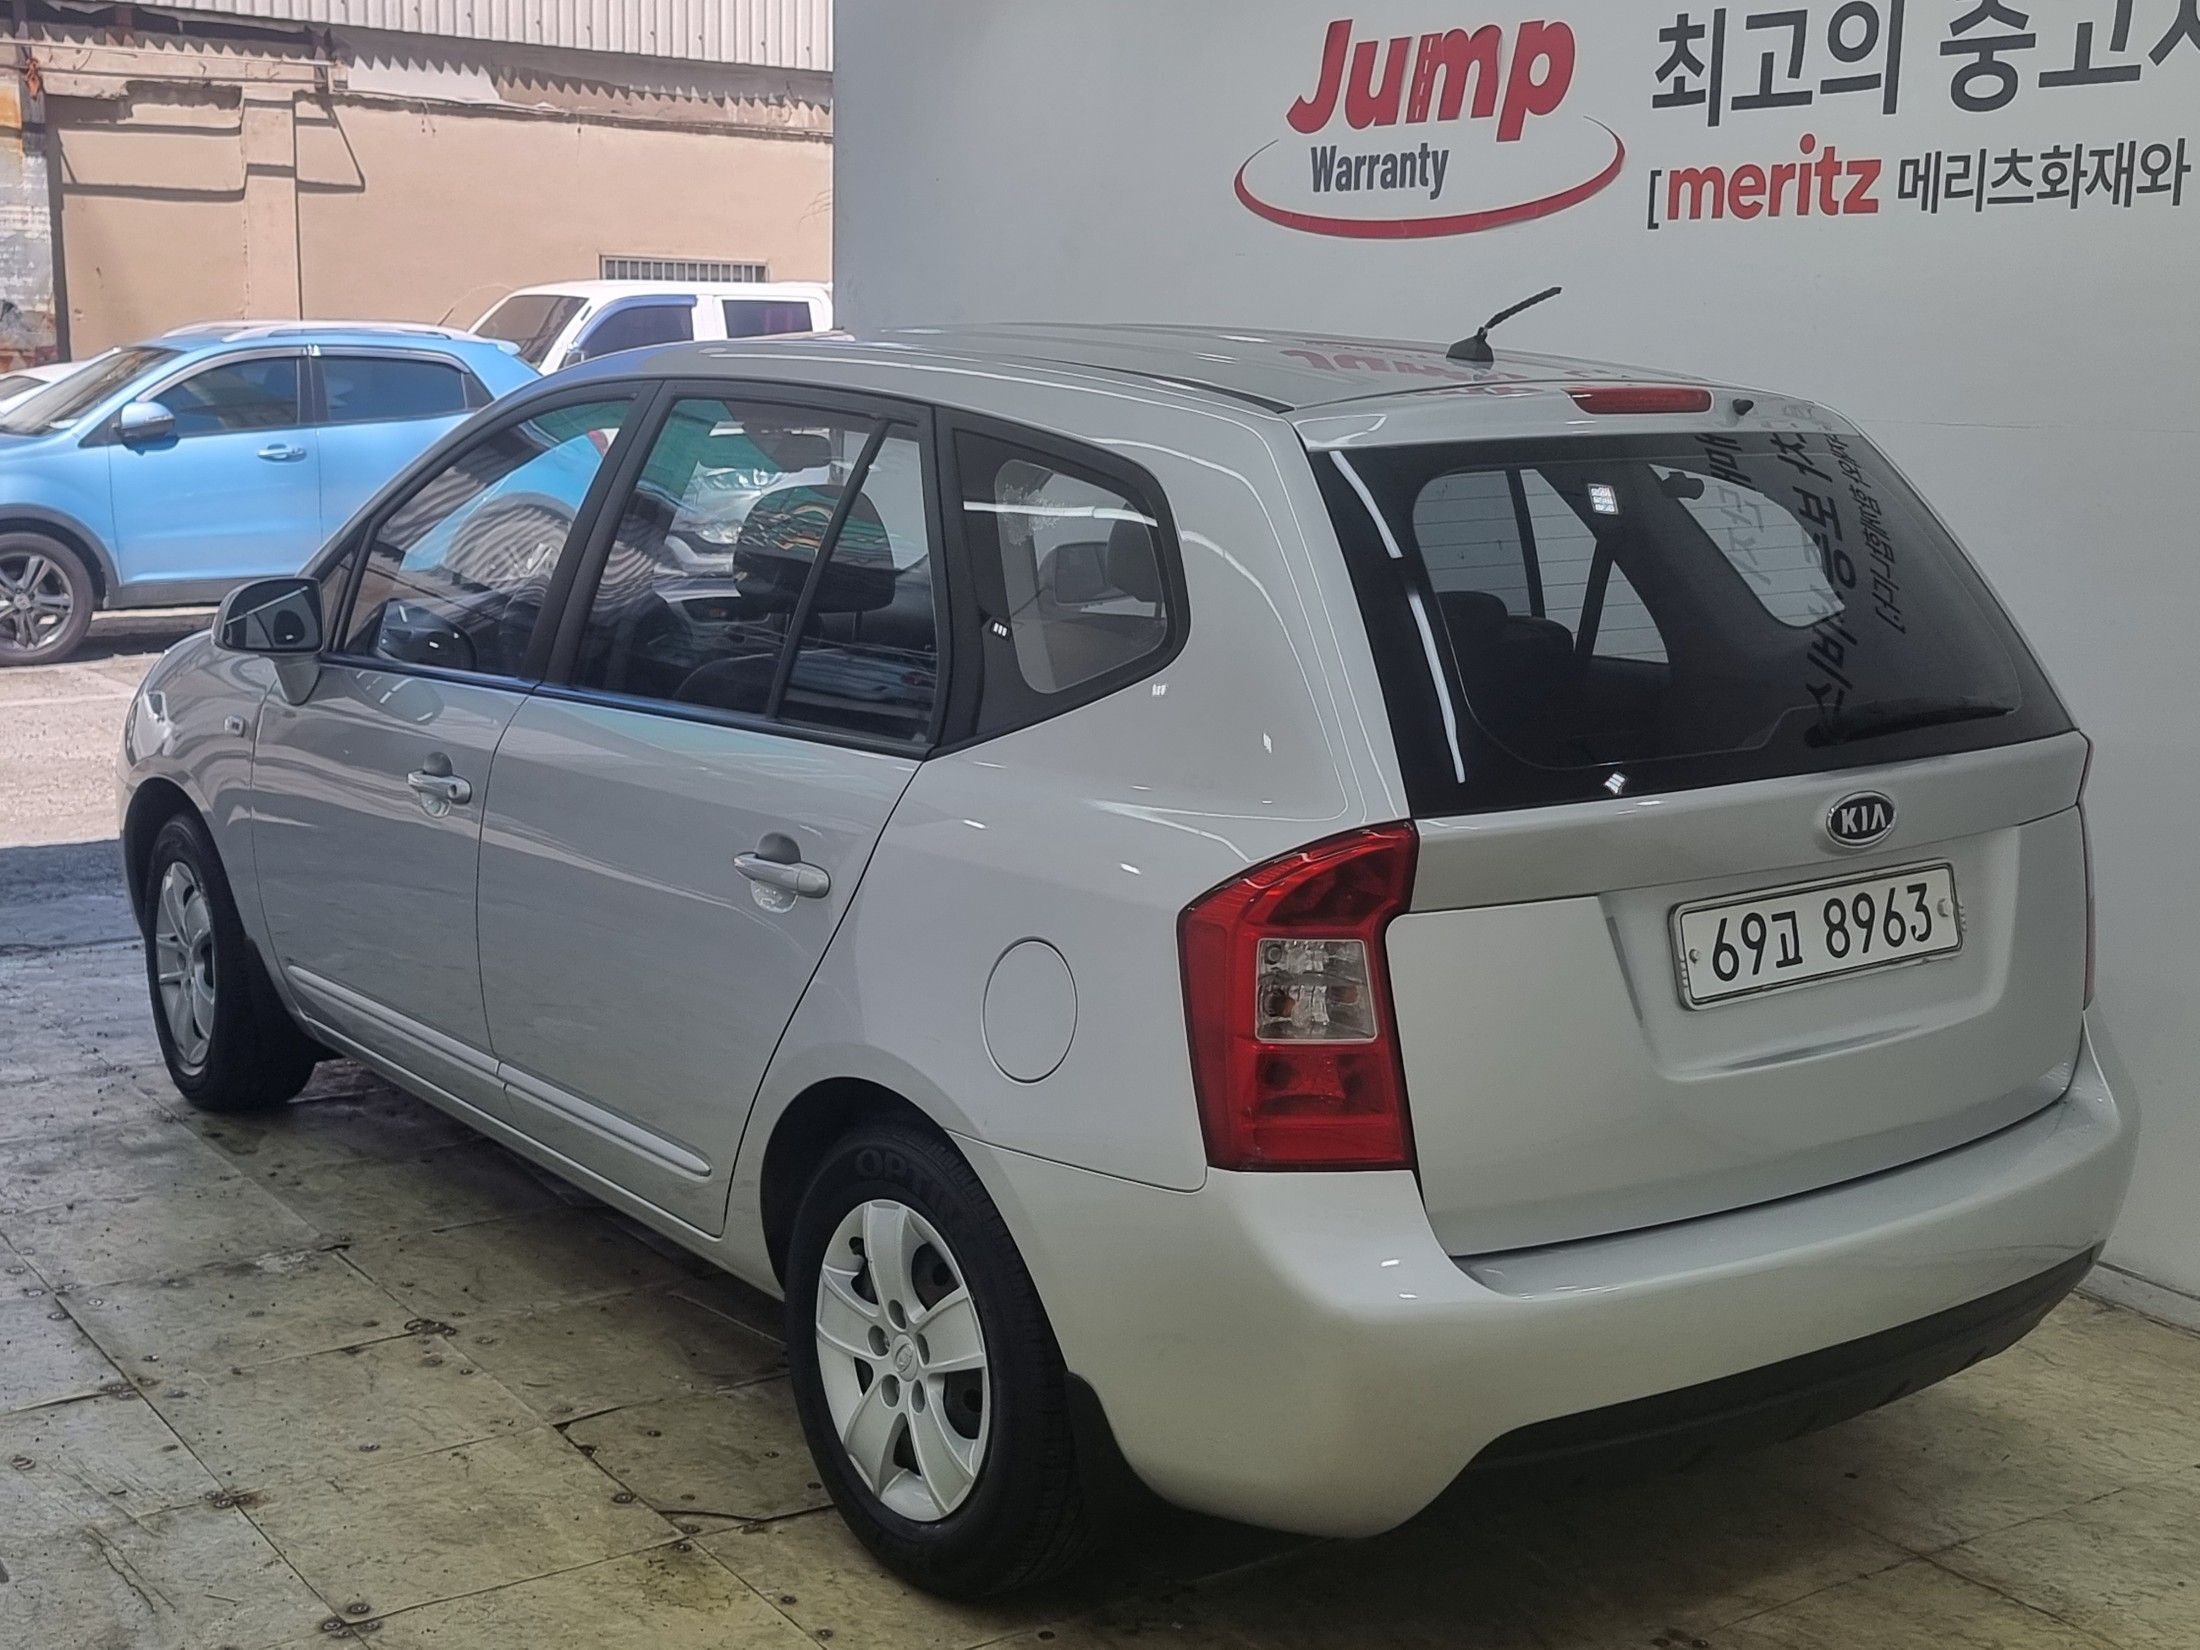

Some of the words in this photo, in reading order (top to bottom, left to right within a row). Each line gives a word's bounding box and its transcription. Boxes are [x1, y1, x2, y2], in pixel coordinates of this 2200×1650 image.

[1286, 18, 1576, 143] Jump
[1651, 0, 1905, 128] 최고의
[1310, 142, 1450, 200] Warranty
[1897, 137, 2192, 214] 메리츠화재와
[1840, 802, 1888, 835] KIA
[1822, 882, 1933, 960] 8963
